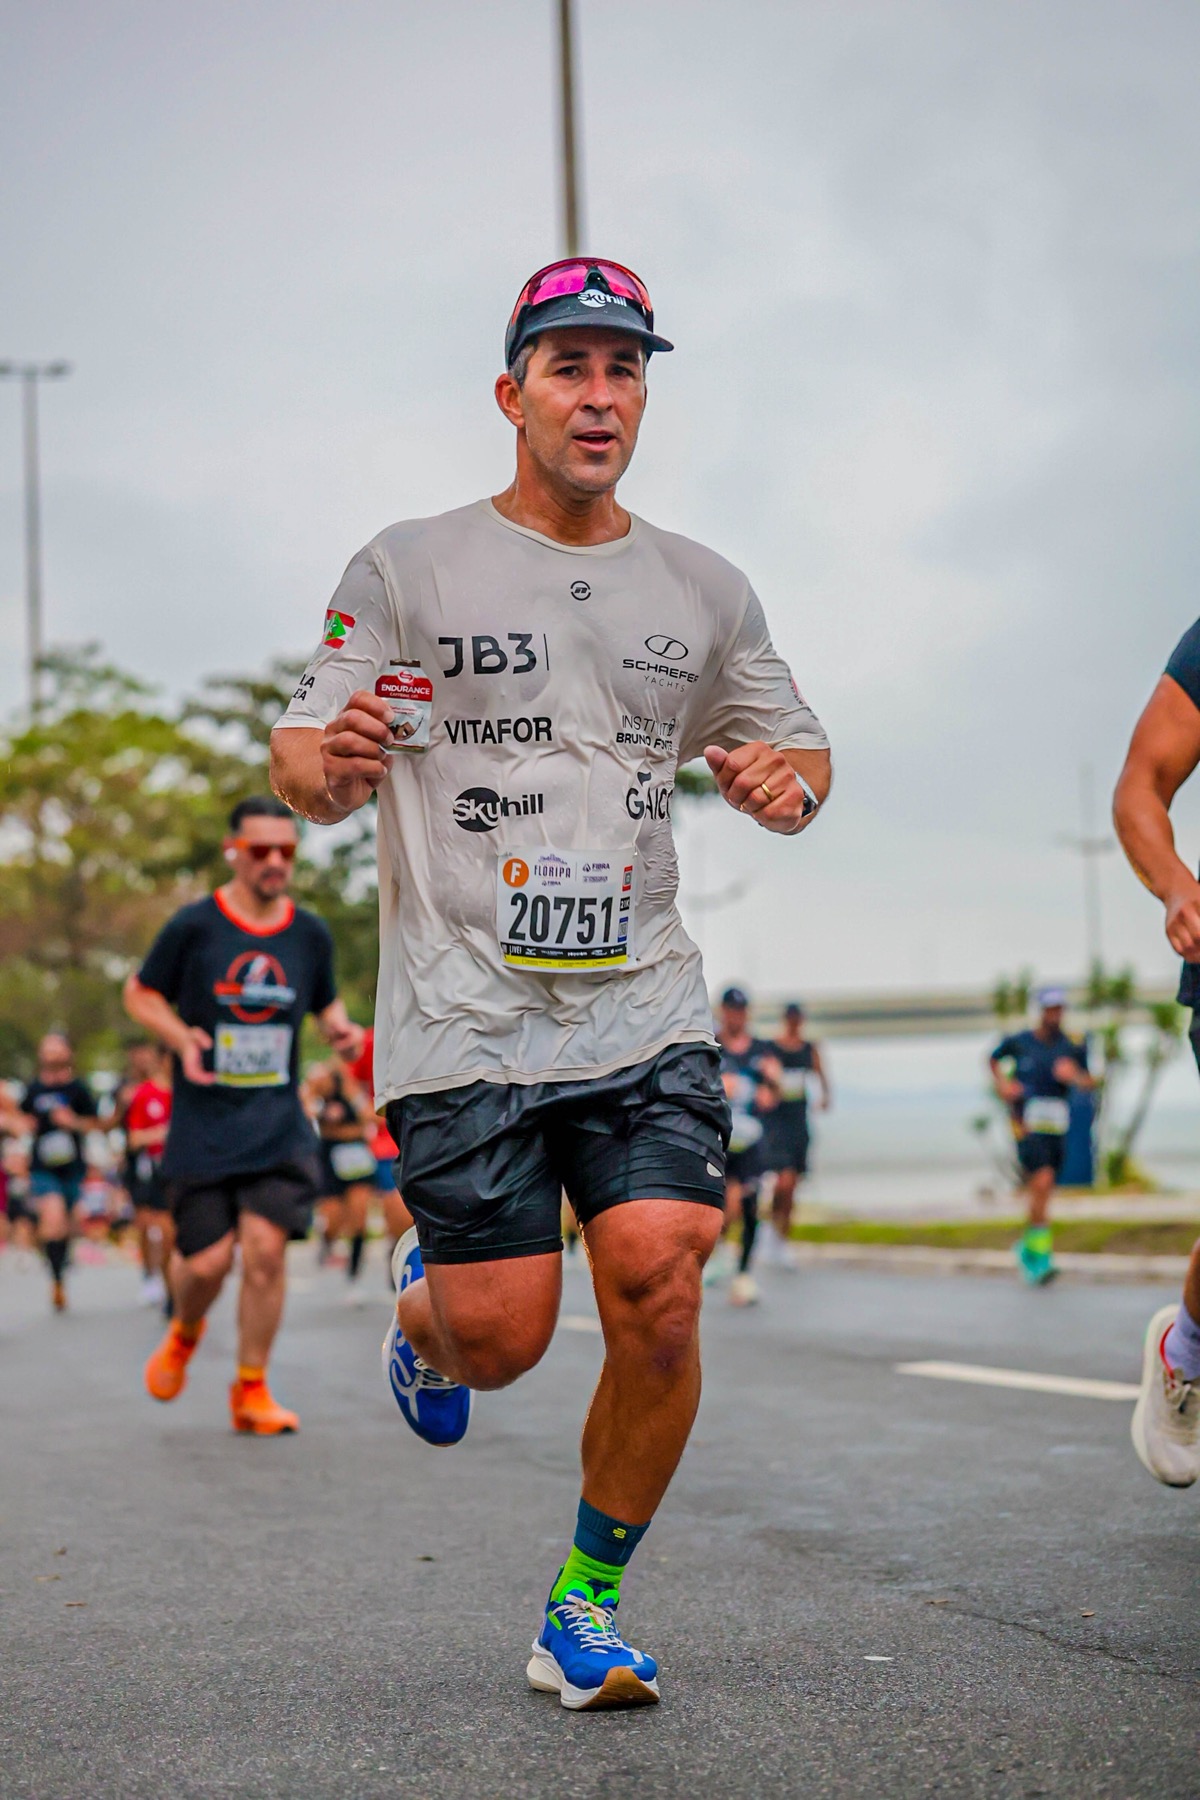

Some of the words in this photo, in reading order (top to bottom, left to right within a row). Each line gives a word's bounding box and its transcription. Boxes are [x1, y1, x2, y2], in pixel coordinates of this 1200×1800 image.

[438, 632, 537, 678] JB3
[381, 683, 431, 695] ENDURANCE
[643, 675, 686, 692] YACHTS
[444, 717, 553, 744] VITAFOR
[616, 732, 652, 747] BRUNO
[510, 862, 521, 883] F
[534, 865, 571, 879] FLORIPA
[509, 893, 613, 945] 20751
